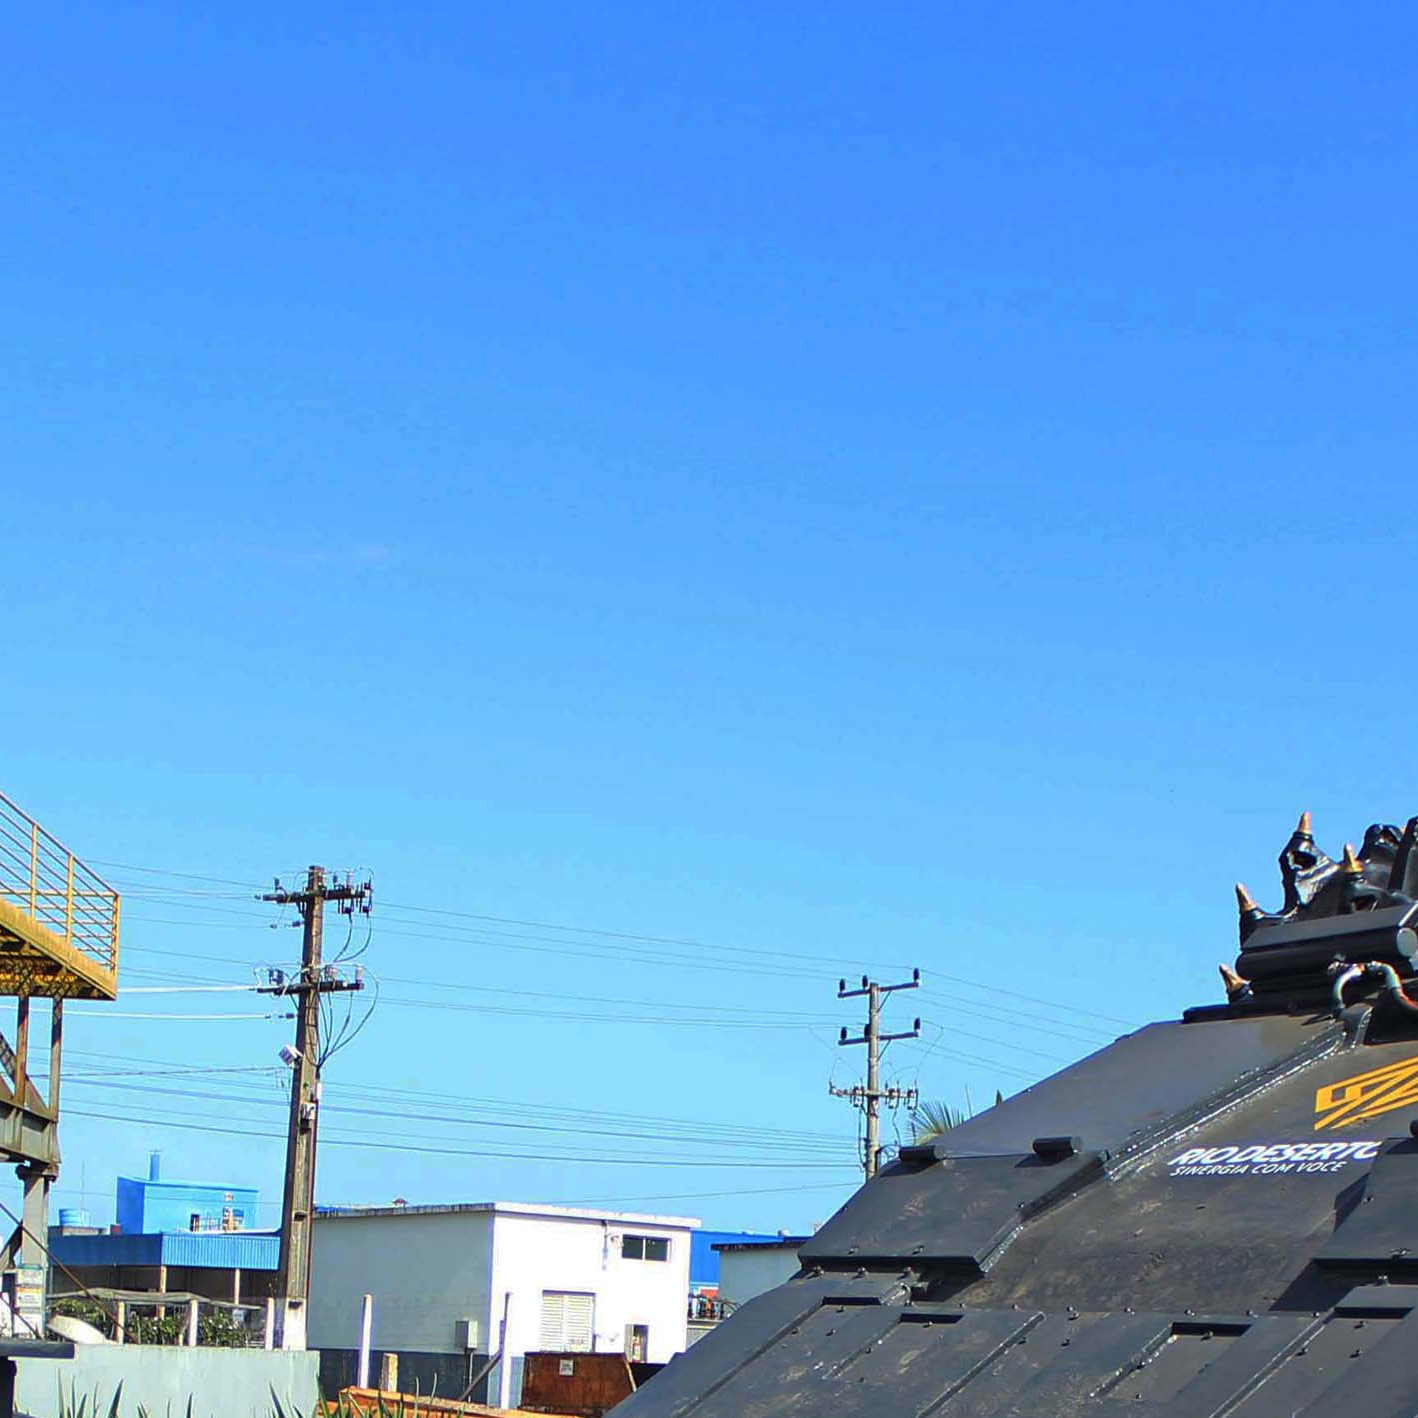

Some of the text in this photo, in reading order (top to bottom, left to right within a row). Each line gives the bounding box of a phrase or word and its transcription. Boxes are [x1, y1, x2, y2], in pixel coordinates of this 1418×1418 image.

[1167, 1147, 1239, 1166] RIO
[1170, 1161, 1347, 1176] SINERGIA COM VOCE
